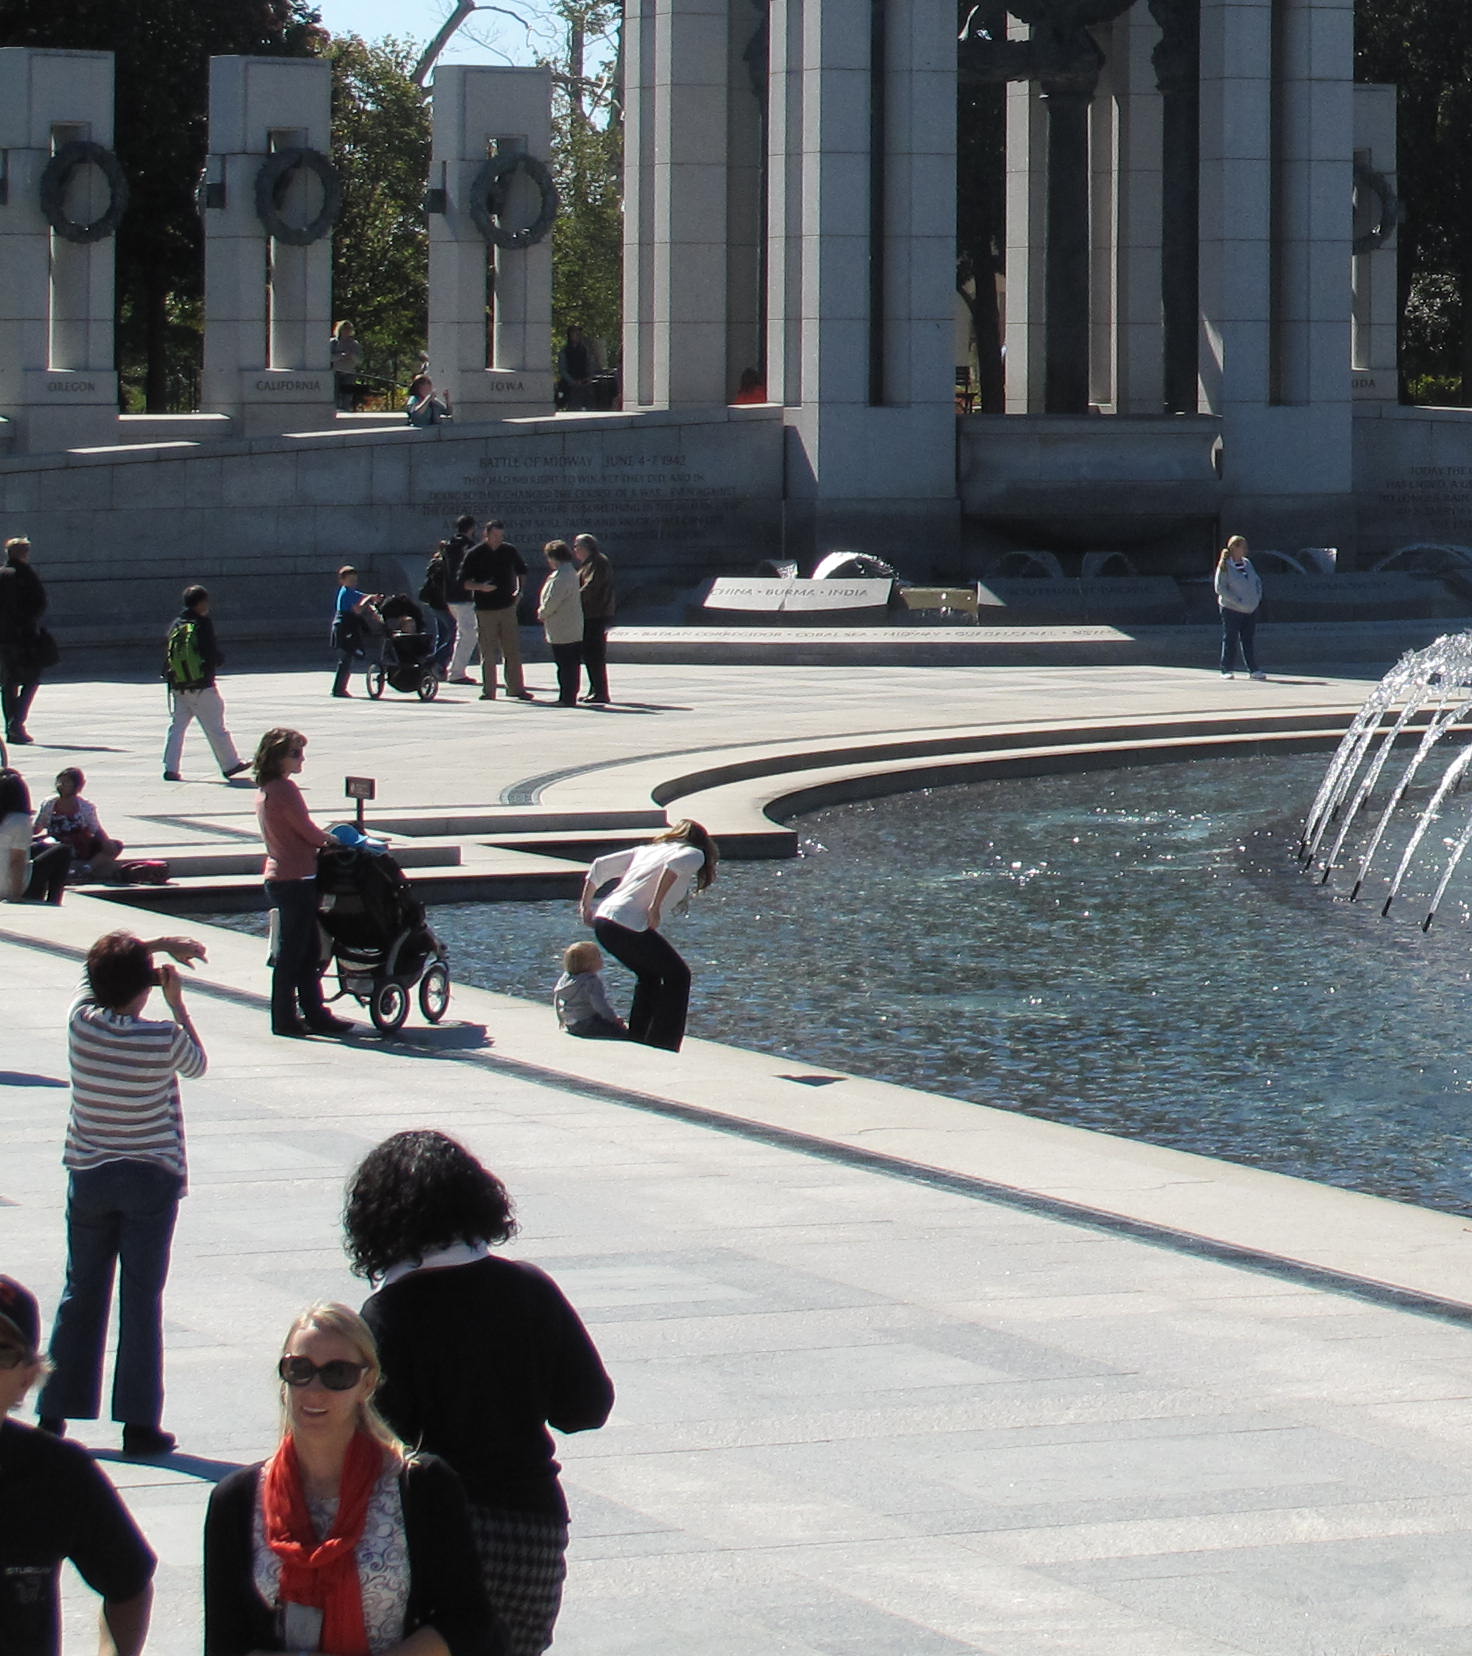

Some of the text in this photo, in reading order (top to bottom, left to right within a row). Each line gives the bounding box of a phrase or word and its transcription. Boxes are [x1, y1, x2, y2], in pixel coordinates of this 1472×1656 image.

[47, 381, 96, 392] OREGON
[256, 380, 321, 392] CALIFORNIA
[490, 381, 525, 392] IOWA
[480, 456, 520, 468] BATTLE
[544, 456, 594, 467] MIDWAY
[711, 588, 868, 597] CHINA BURMA INDIA
